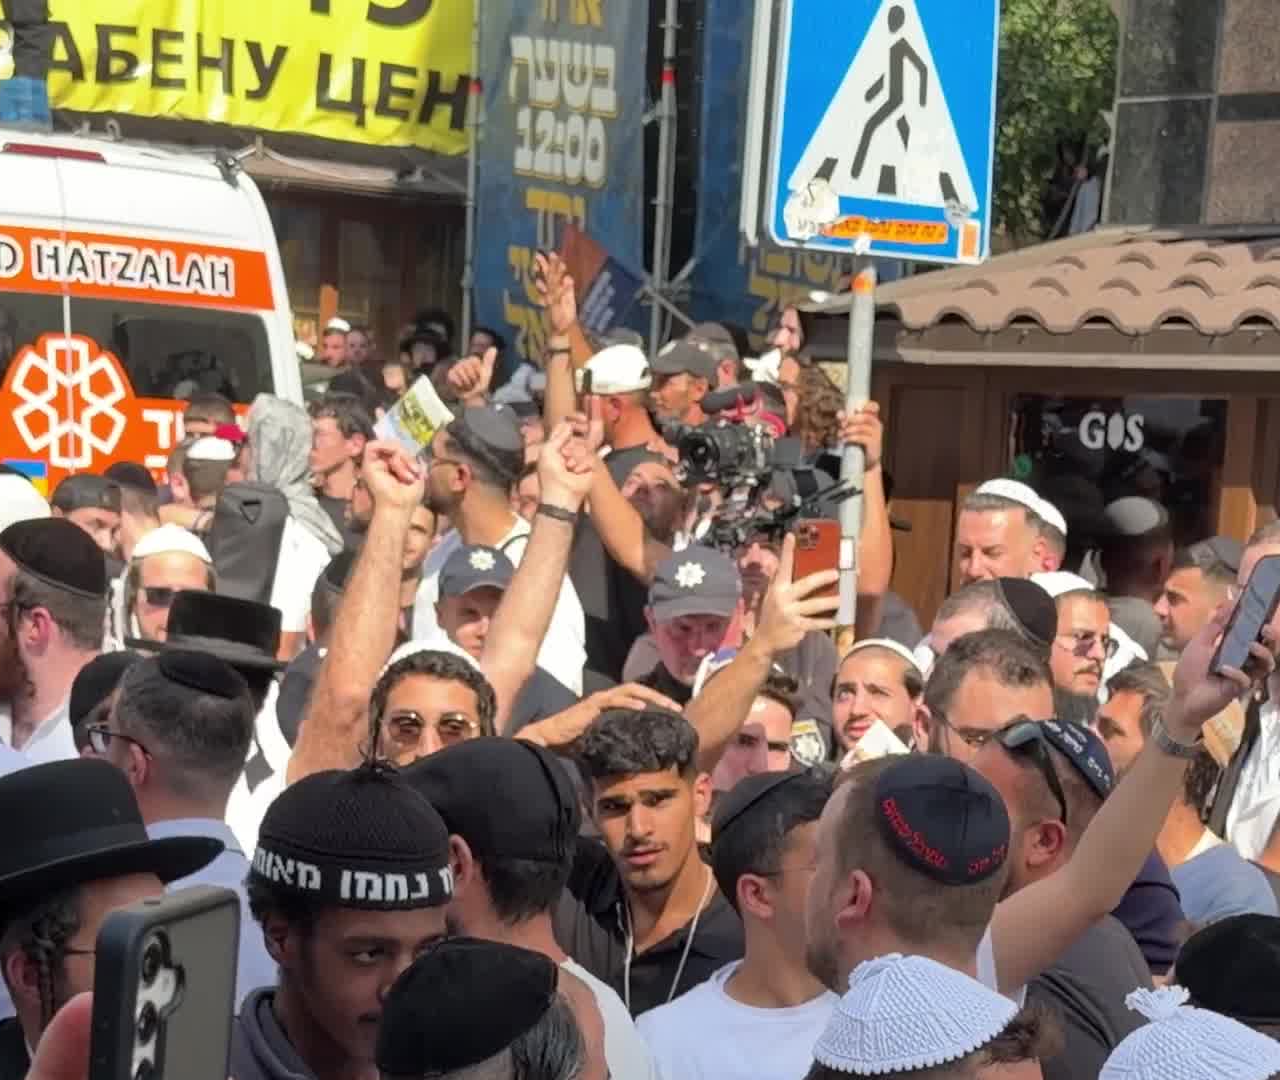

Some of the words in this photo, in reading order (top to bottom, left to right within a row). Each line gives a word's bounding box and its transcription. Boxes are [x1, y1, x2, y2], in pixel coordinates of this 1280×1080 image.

[513, 105, 608, 189] 12:00
[36, 242, 232, 293] HATZALAH
[254, 847, 322, 891] מאומ
[339, 868, 429, 901] נחמן
